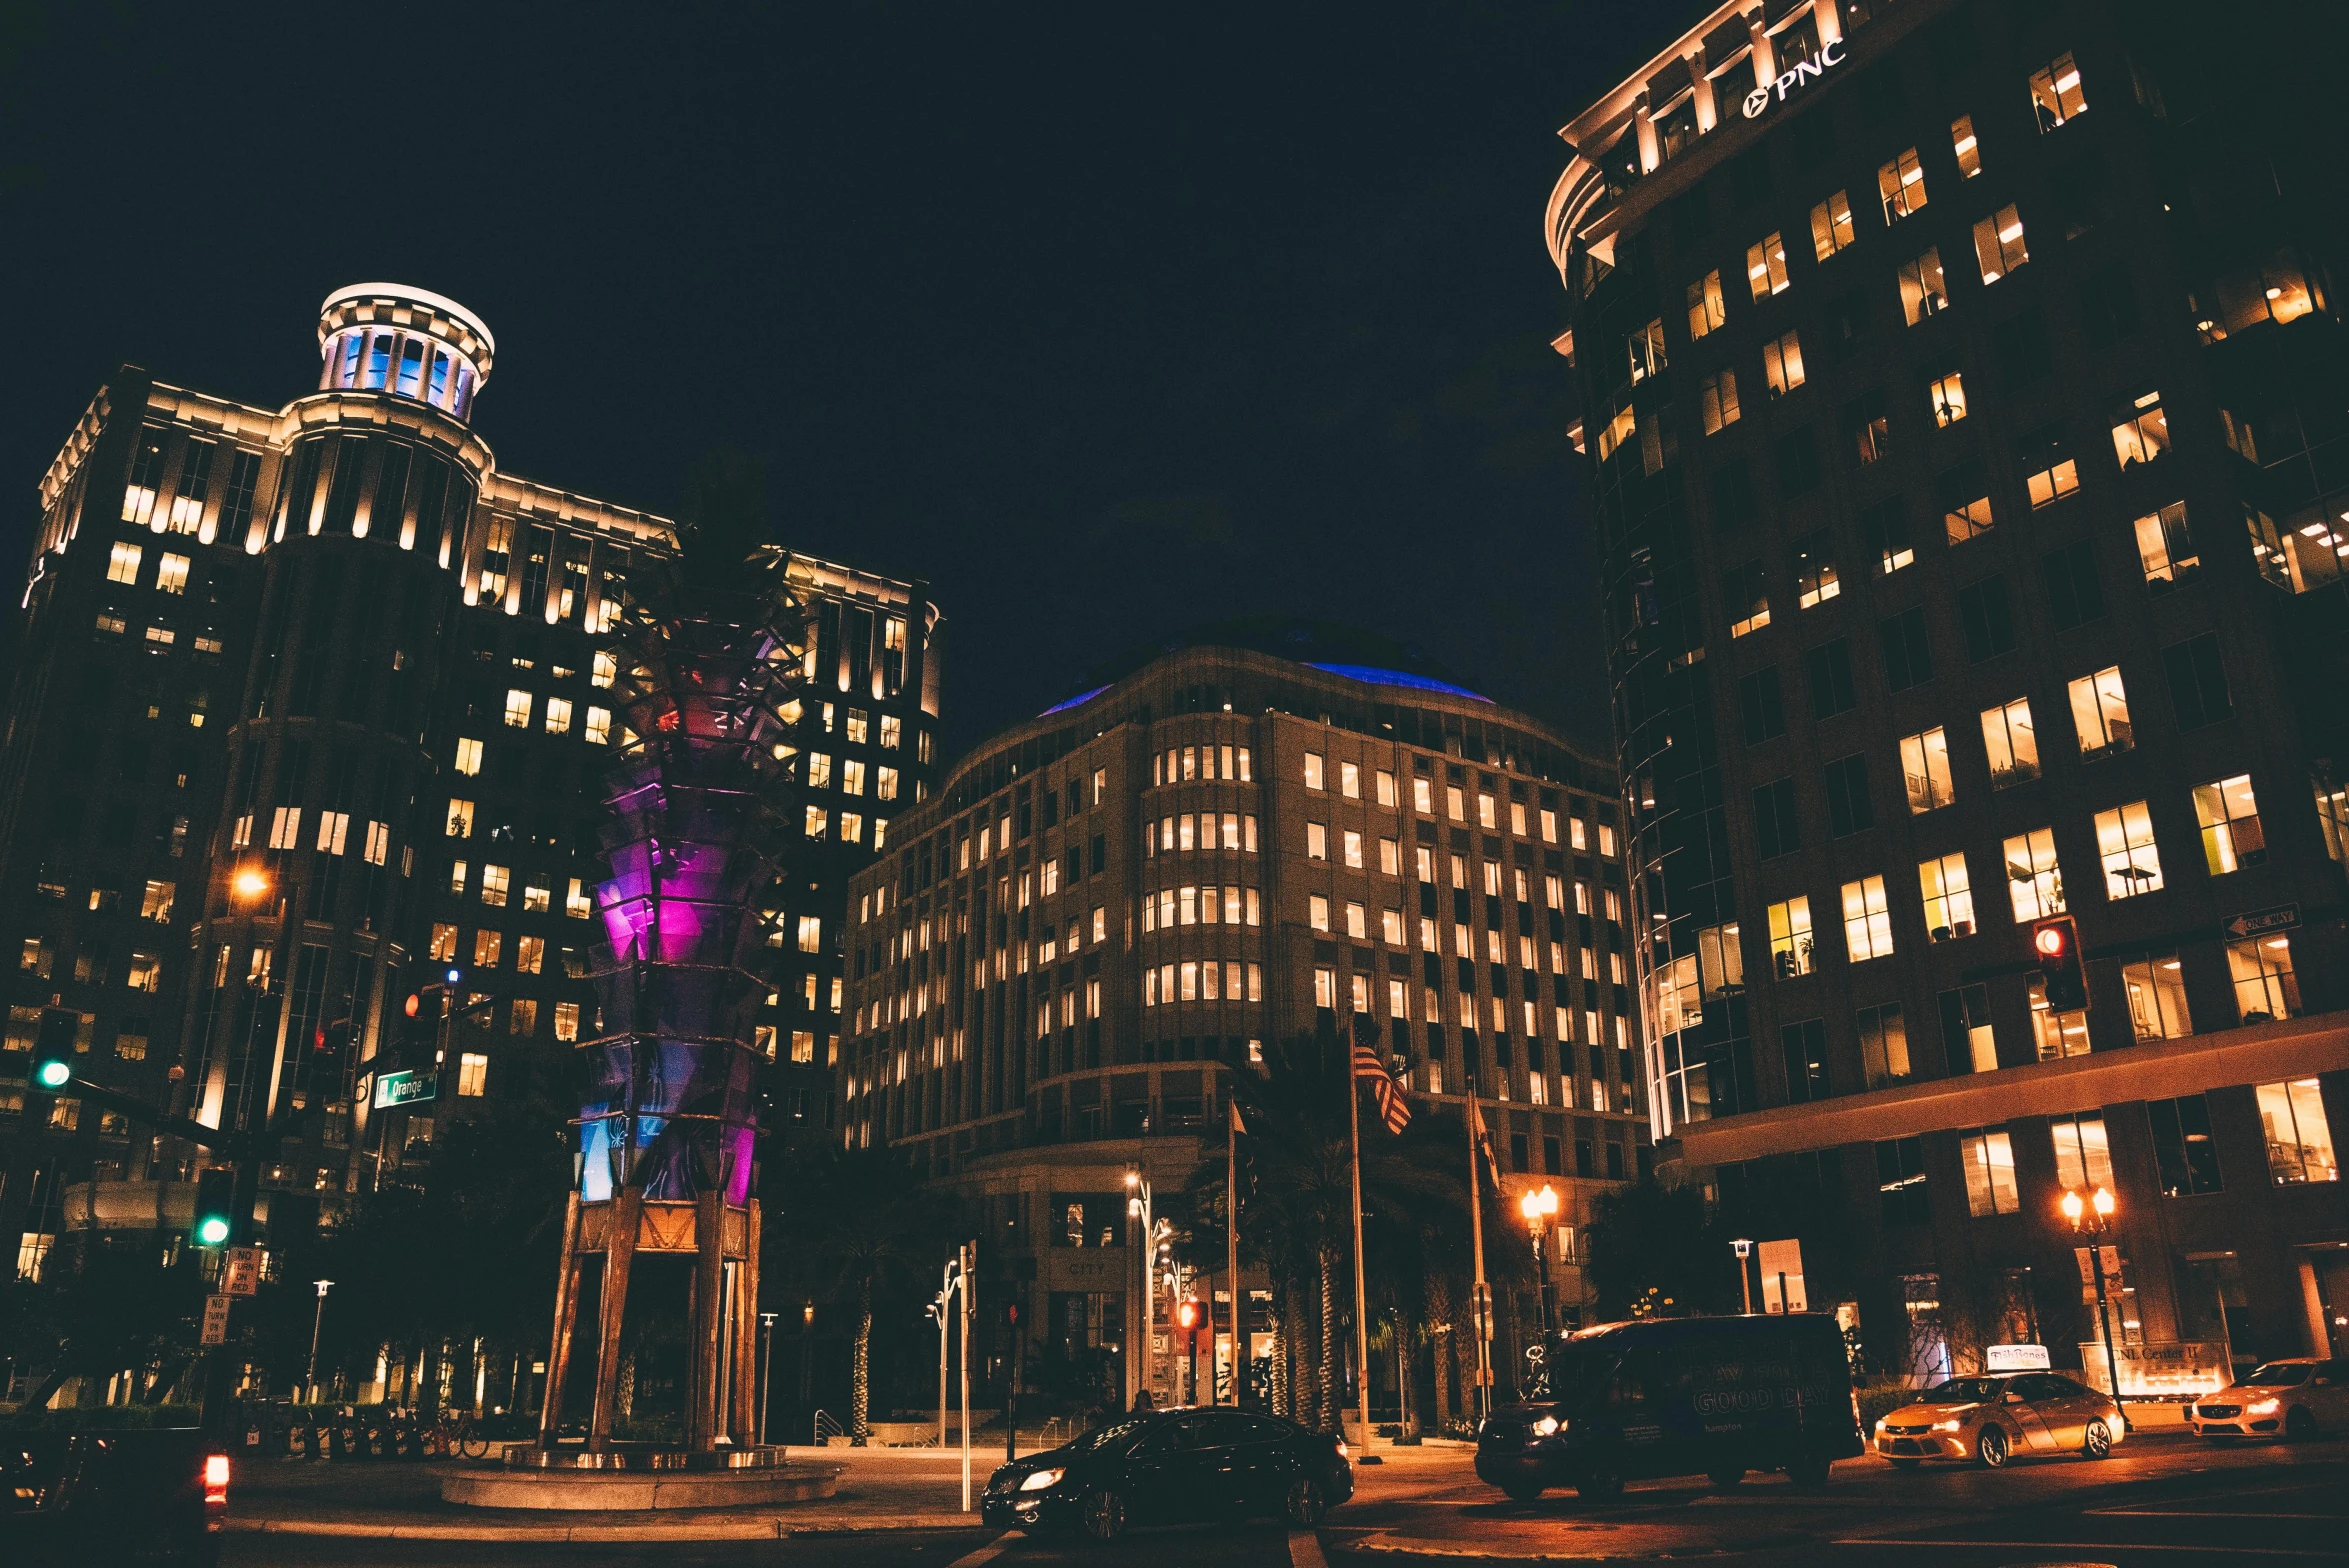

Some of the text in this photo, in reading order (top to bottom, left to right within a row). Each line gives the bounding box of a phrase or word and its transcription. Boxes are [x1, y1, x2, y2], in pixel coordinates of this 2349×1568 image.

[1774, 37, 1846, 101] PNC
[2245, 911, 2291, 929] ONE WAY
[392, 1080, 422, 1098] Orange
[237, 1251, 252, 1260] NO
[234, 1262, 254, 1271] TURN
[1069, 1263, 1104, 1275] CITY
[236, 1273, 248, 1281] ON
[231, 1283, 248, 1291] RED
[211, 1298, 224, 1308] NO
[208, 1311, 224, 1320] TURN
[209, 1322, 219, 1331] ON
[205, 1334, 219, 1342] RED
[2142, 1347, 2183, 1361] Center
[2187, 1346, 2198, 1358] II
[1693, 1382, 1830, 1415] GOOD DAY
[1704, 1422, 1742, 1433] hampton
